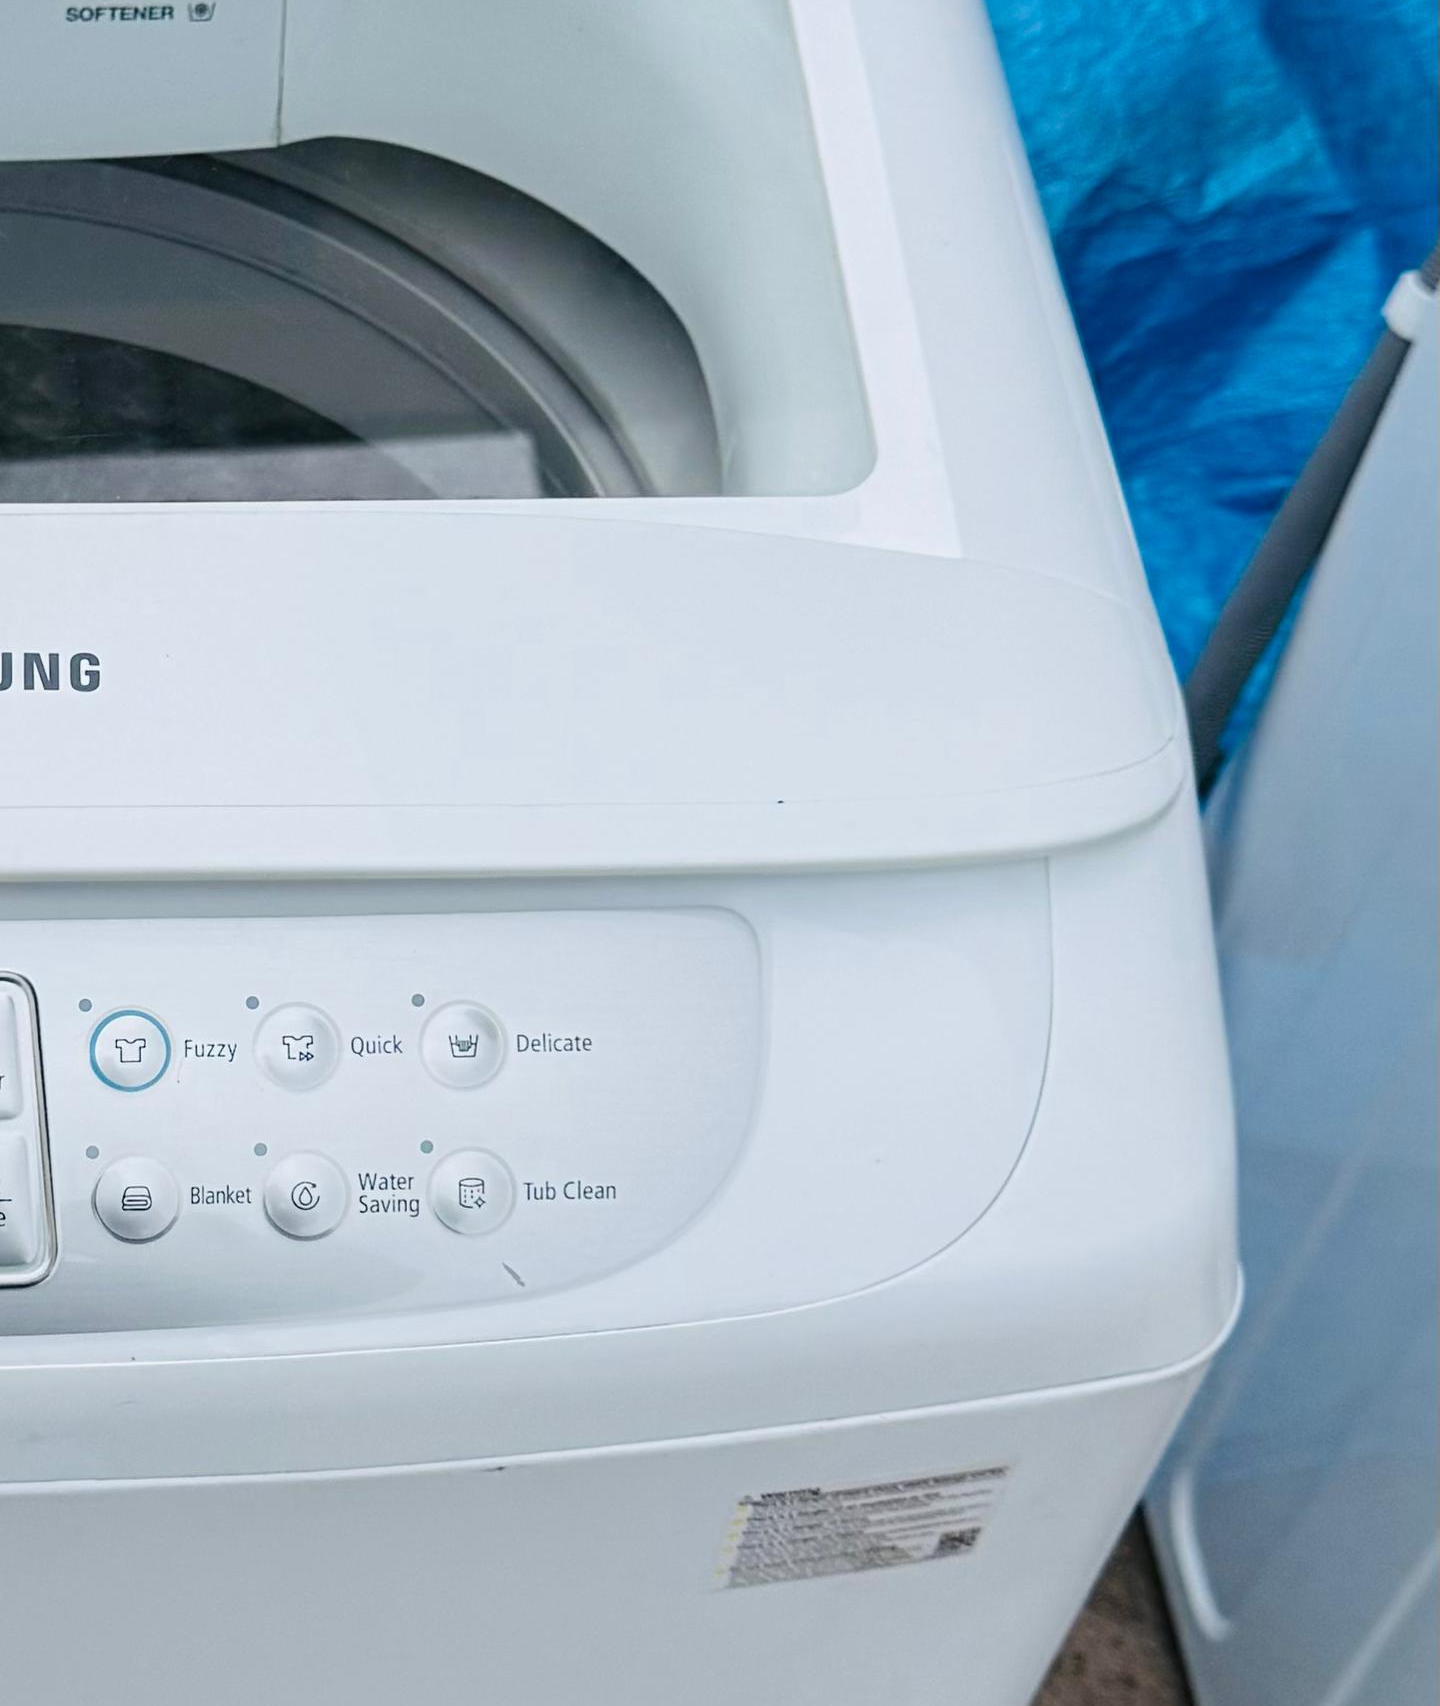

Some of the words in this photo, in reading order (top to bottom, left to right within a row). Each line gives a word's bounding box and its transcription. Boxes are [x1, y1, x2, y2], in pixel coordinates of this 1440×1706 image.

[65, 5, 175, 23] SOFTENER
[184, 1039, 238, 1063] Fuzzy
[350, 1034, 404, 1058] Quick
[516, 1032, 593, 1053] Delicate
[358, 1172, 414, 1191] Water
[523, 1181, 557, 1201] Tub
[563, 1180, 617, 1200] Clean
[190, 1184, 252, 1205] Blanket
[359, 1194, 420, 1218] Saving
